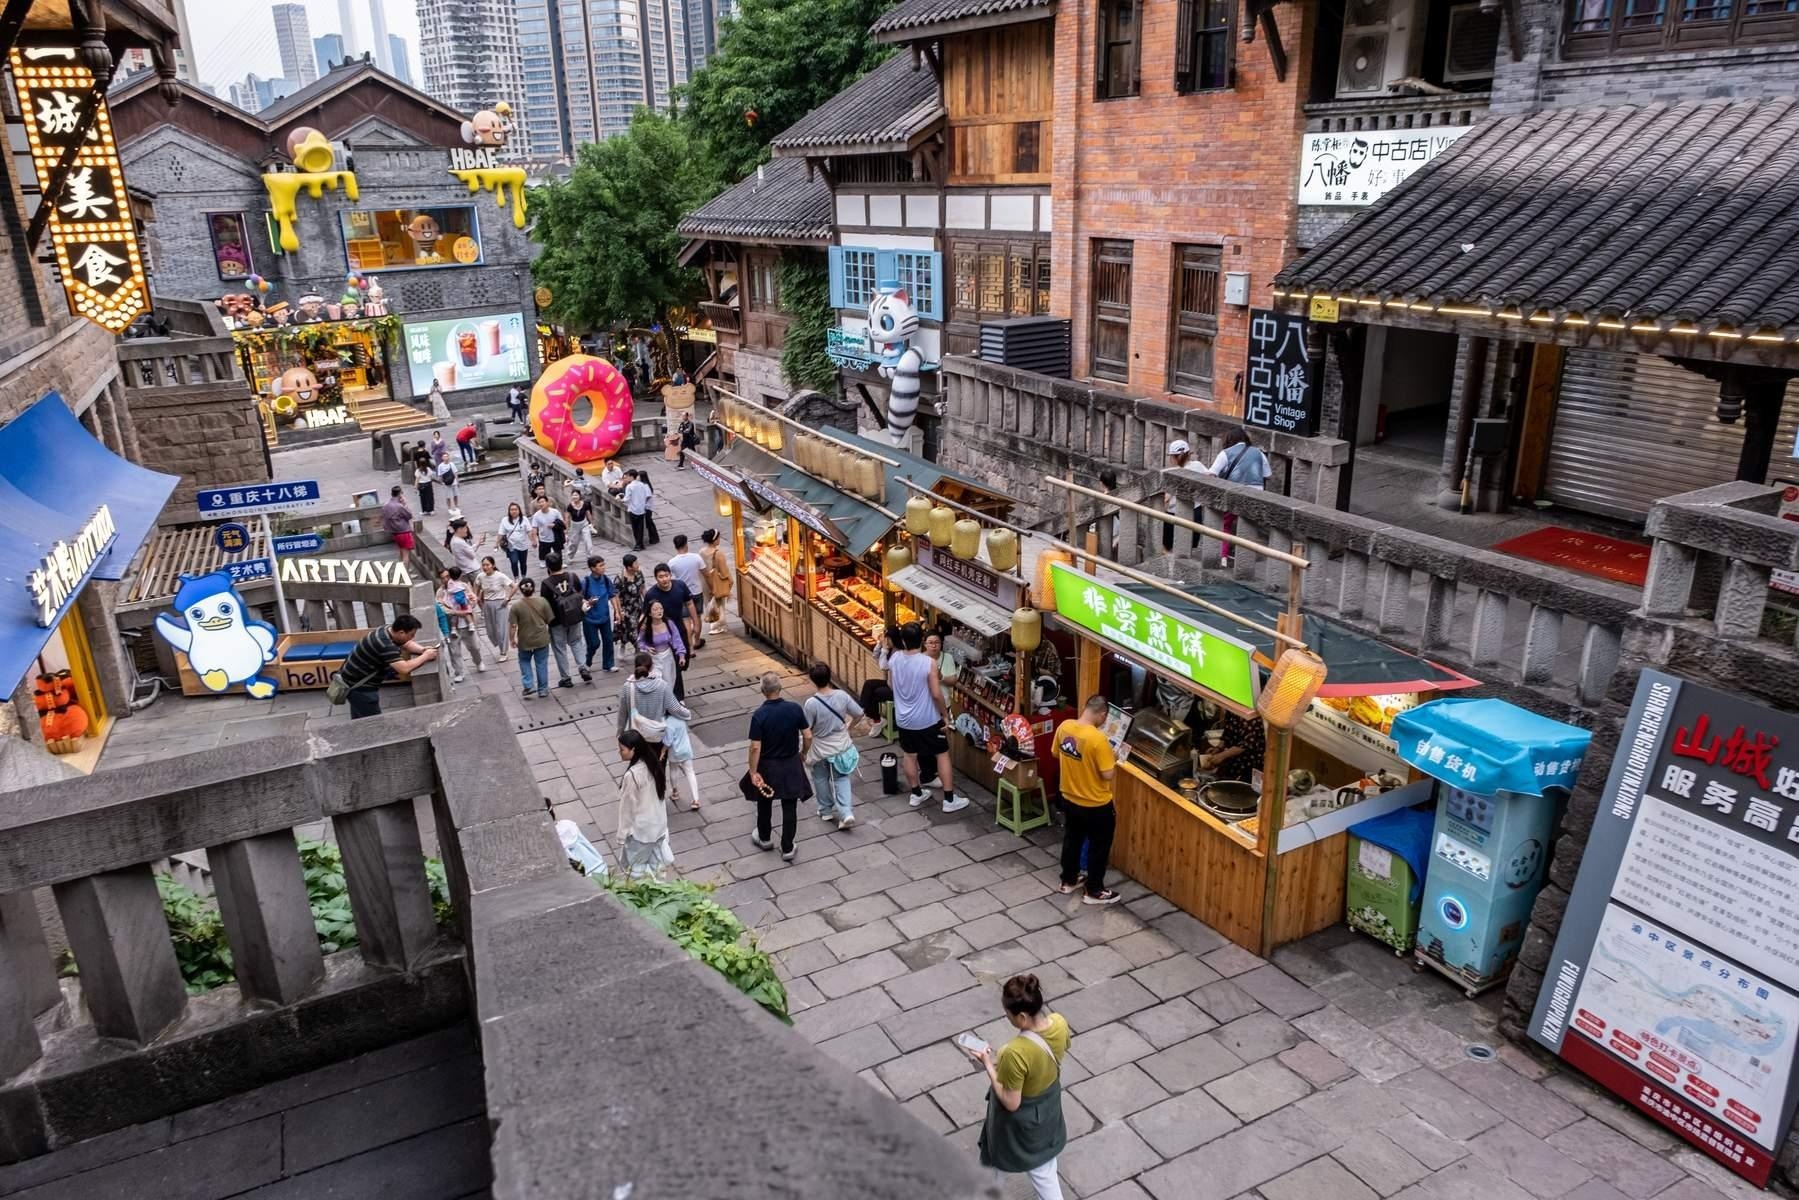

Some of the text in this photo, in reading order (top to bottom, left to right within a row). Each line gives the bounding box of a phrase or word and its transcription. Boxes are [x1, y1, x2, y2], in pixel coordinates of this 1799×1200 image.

[450, 147, 497, 170] HBAF
[1372, 138, 1429, 162] 中古店
[24, 47, 128, 288] 城美食
[1304, 159, 1351, 187] 八幡
[1246, 313, 1277, 425] 中古店
[1275, 321, 1310, 404] 八幡
[1274, 403, 1307, 420] Vintage
[1274, 415, 1296, 431] Shop
[228, 485, 308, 505] 重庆十八梯
[230, 562, 266, 578] 艺术鸭
[281, 557, 413, 585] ARTYAYA
[1631, 922, 1770, 1000] 渝中区景点分布图
